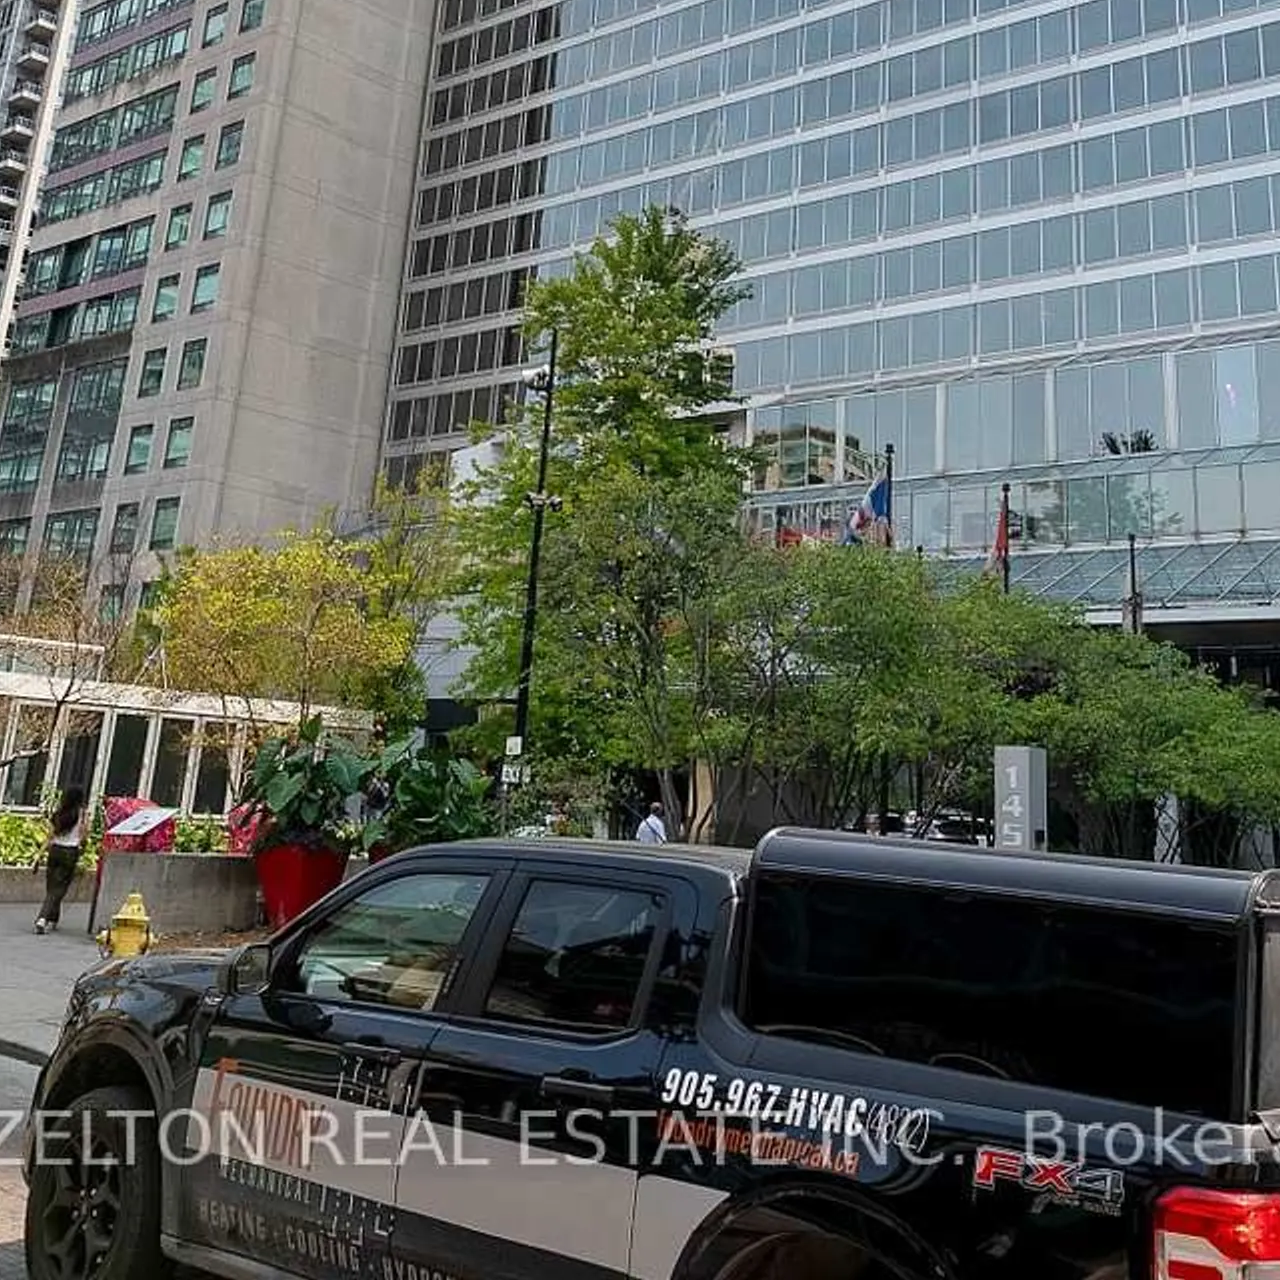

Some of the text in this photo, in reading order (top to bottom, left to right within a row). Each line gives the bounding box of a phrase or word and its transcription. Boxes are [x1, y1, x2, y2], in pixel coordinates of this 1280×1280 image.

[221, 1152, 311, 1204] MECHANICAL
[974, 1145, 1124, 1203] FX4
[285, 1223, 360, 1272] COOLING
